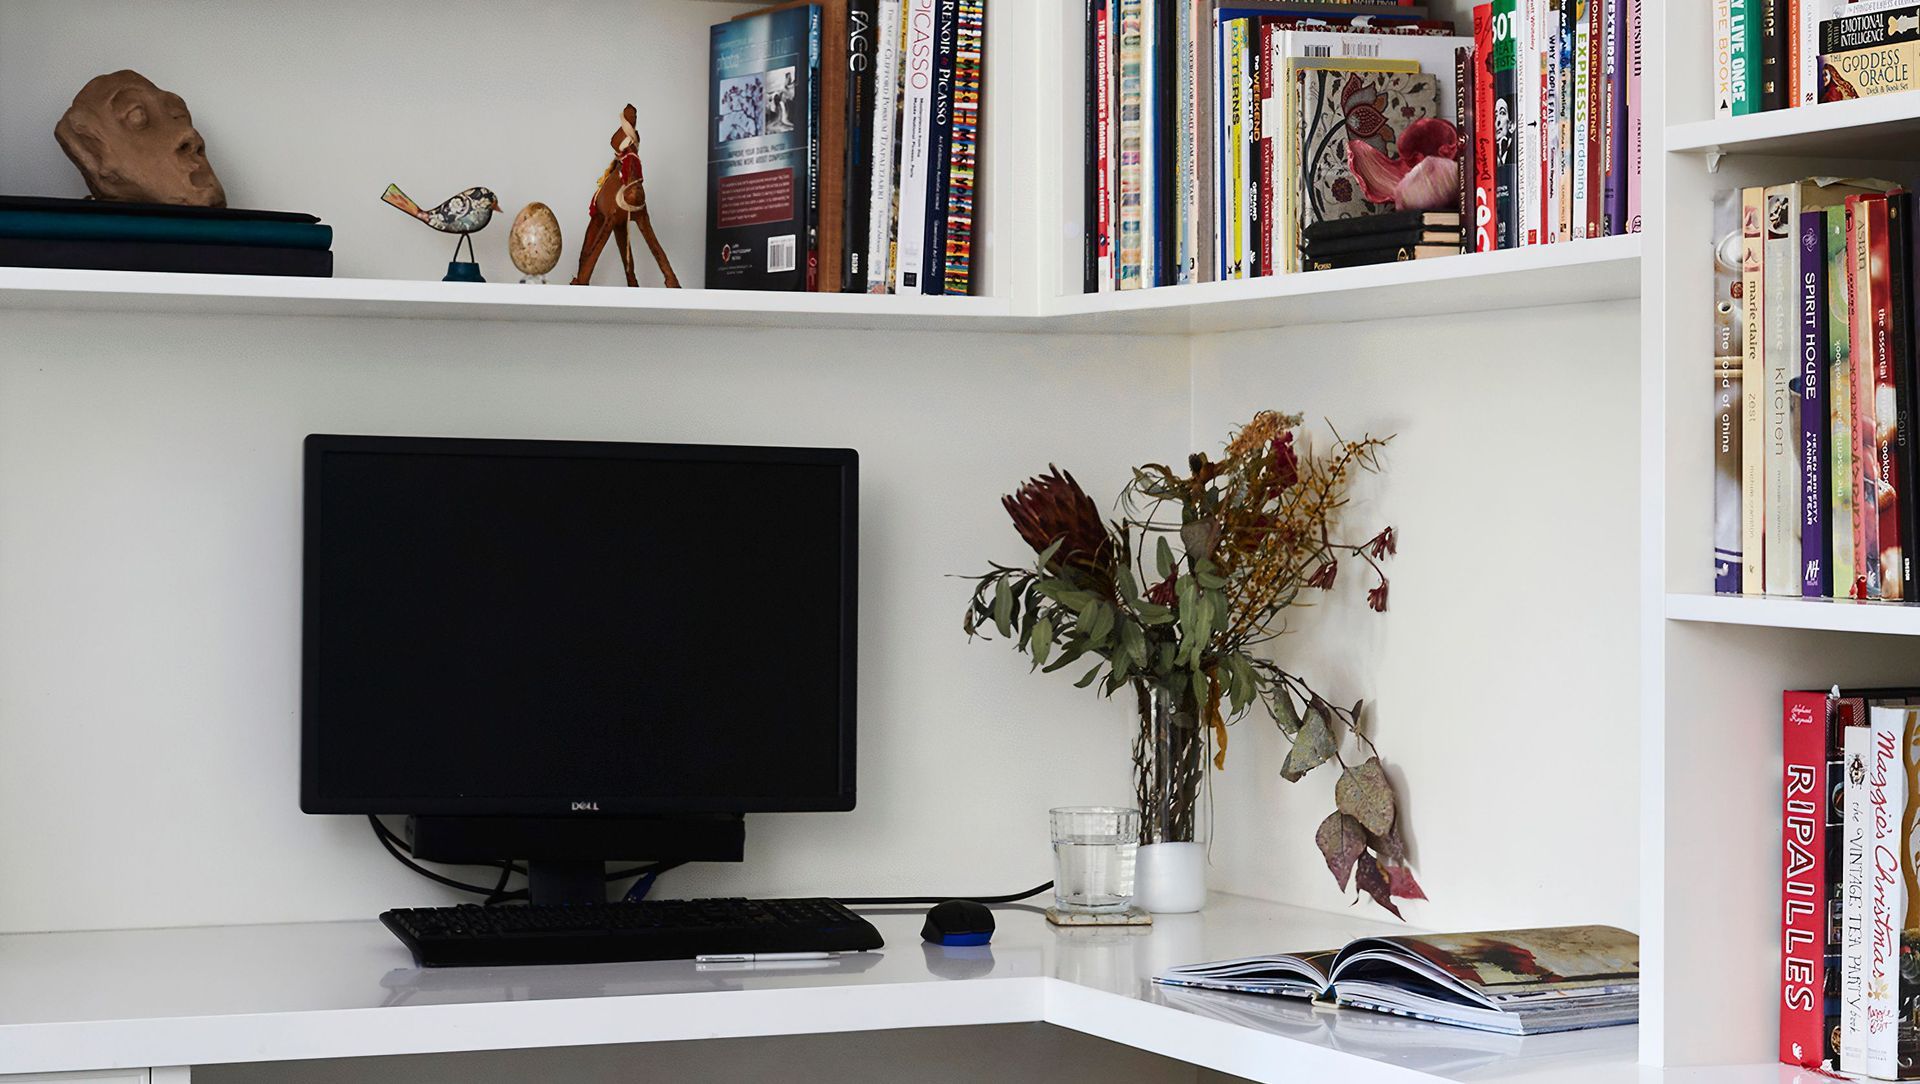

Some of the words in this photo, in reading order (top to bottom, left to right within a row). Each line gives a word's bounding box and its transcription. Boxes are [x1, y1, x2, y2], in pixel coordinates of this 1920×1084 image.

[1560, 0, 1568, 11] he
[1560, 12, 1568, 27] Art
[1763, 0, 1776, 38] ENCE
[1840, 13, 1884, 34] EMOTIONAL
[911, 0, 932, 89] PICASSO
[940, 1, 954, 55] RENOIR
[1098, 19, 1107, 37] THE
[1529, 16, 1537, 50] Whiteley
[1548, 35, 1557, 59] WHY
[1560, 29, 1568, 38] of
[1731, 14, 1746, 55] LIVE
[1840, 28, 1884, 47] INTELLIGENCE
[1098, 39, 1107, 119] PHOTOGRAPHER'S
[1231, 26, 1240, 126] PATTERNS
[1263, 34, 1271, 90] WALLPAPER
[1457, 60, 1467, 83] THE
[1577, 33, 1588, 121] EXPRESS
[1719, 37, 1729, 94] BOOK
[1842, 48, 1900, 73] GODDESS
[1859, 64, 1908, 87] ORACLE
[936, 69, 951, 125] PICASSO
[1547, 63, 1557, 99] PEOPLE
[1559, 79, 1567, 118] Painting
[1606, 83, 1613, 92] IN
[1731, 56, 1746, 104] ONCE
[1886, 83, 1899, 92] Book
[1252, 71, 1261, 142] WEEKEND
[1457, 86, 1467, 127] SECRET
[1540, 109, 1548, 119] of
[1547, 102, 1556, 123] FAIL
[1590, 78, 1598, 142] McCARTNEY
[1098, 120, 1107, 160] MANUAL
[1540, 121, 1548, 162] Crochet
[1263, 144, 1271, 184] TAPETEN
[1458, 156, 1467, 190] RHONDA
[1576, 123, 1587, 200] gardening
[1263, 194, 1271, 230] PAPIERS
[1458, 192, 1466, 215] BYRNE
[1263, 233, 1271, 265] PEINTS
[1775, 252, 1785, 298] marie
[1749, 280, 1758, 320] marie
[1804, 271, 1816, 328] SPIRIT
[1878, 307, 1886, 327] the
[1722, 326, 1731, 349] the
[1749, 322, 1758, 360] claire
[1774, 301, 1785, 351] claire
[1722, 356, 1731, 387] food
[1804, 333, 1817, 400] HOUSE
[1834, 339, 1842, 391] cookbook
[1878, 330, 1888, 379] essential
[1722, 393, 1732, 408] of
[1748, 392, 1757, 423] zest
[1849, 361, 1858, 451] COOKBOOK
[1722, 413, 1732, 453] china
[1897, 409, 1908, 447] Soup
[1836, 479, 1844, 497] the
[1869, 730, 1897, 840] Maggie's
[571, 801, 600, 811] DELL
[1852, 801, 1860, 823] the
[1848, 827, 1864, 908] VINTAGE
[1785, 763, 1816, 1012] RIPAILLES
[1848, 913, 1862, 948] TEA
[1872, 845, 1898, 979] Christmas
[1846, 955, 1863, 1007] PARTY
